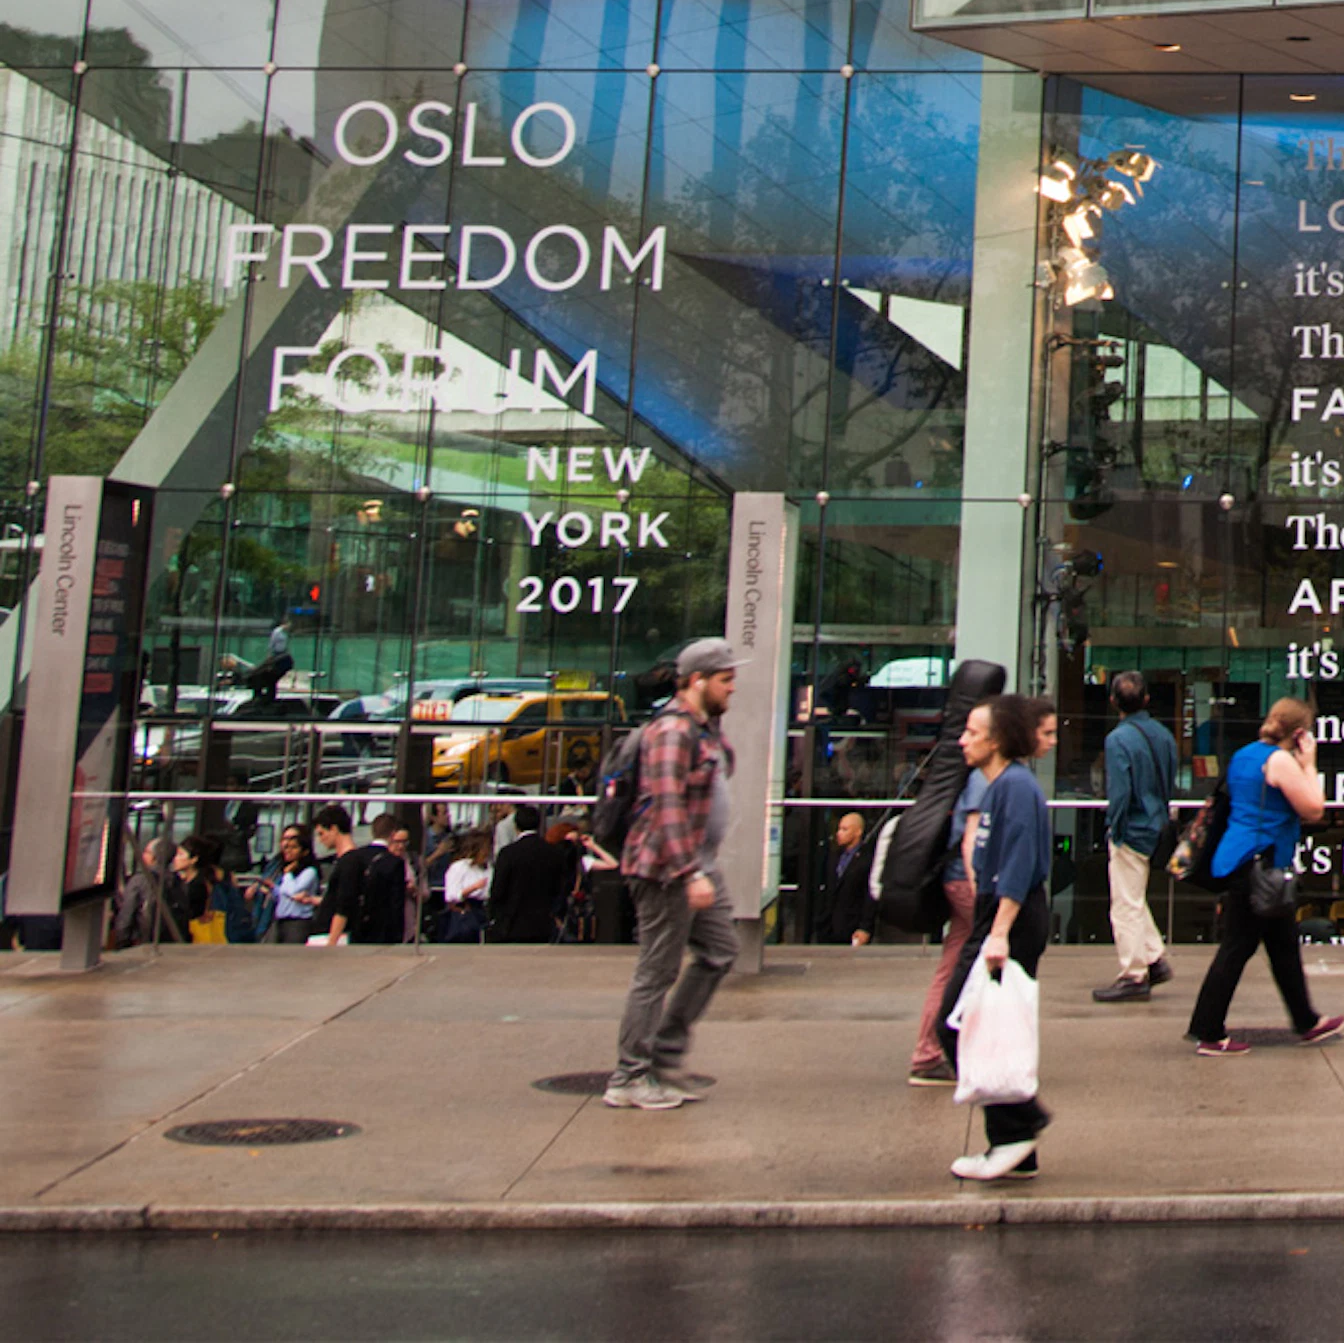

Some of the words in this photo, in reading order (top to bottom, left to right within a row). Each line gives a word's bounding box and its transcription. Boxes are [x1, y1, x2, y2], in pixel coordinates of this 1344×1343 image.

[333, 100, 577, 168] OSLO
[222, 223, 668, 292] FREEDOM
[1294, 261, 1344, 297] it's
[269, 346, 599, 415] FORUM
[526, 446, 651, 483] NEW
[1289, 451, 1341, 488] it's
[57, 504, 82, 571] Lincoln
[521, 511, 670, 548] YORK
[746, 520, 766, 585] Lincoln
[52, 574, 76, 636] Center
[516, 575, 639, 613] 2017
[741, 588, 762, 648] Center
[1286, 642, 1338, 679] it's
[1293, 837, 1333, 874] t's
